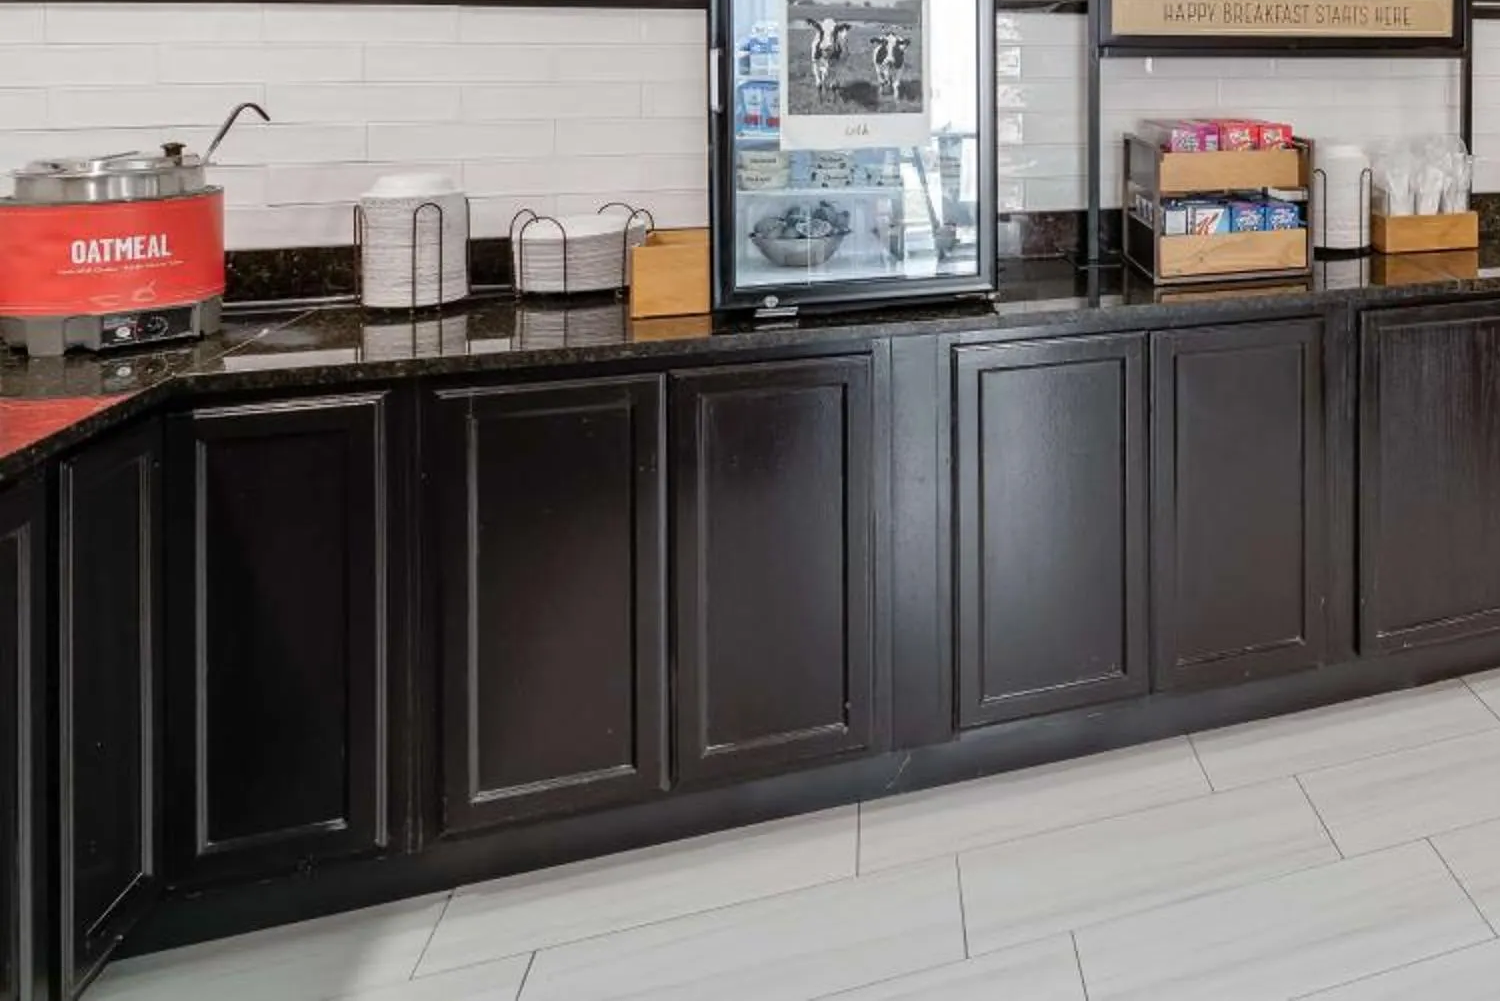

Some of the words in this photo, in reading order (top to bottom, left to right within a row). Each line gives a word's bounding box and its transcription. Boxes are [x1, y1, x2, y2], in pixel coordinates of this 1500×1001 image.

[1163, 3, 1216, 22] HAPPY
[1223, 3, 1310, 24] BREAKFAST
[1315, 5, 1369, 26] STARTS
[71, 234, 172, 264] OATMEAL
